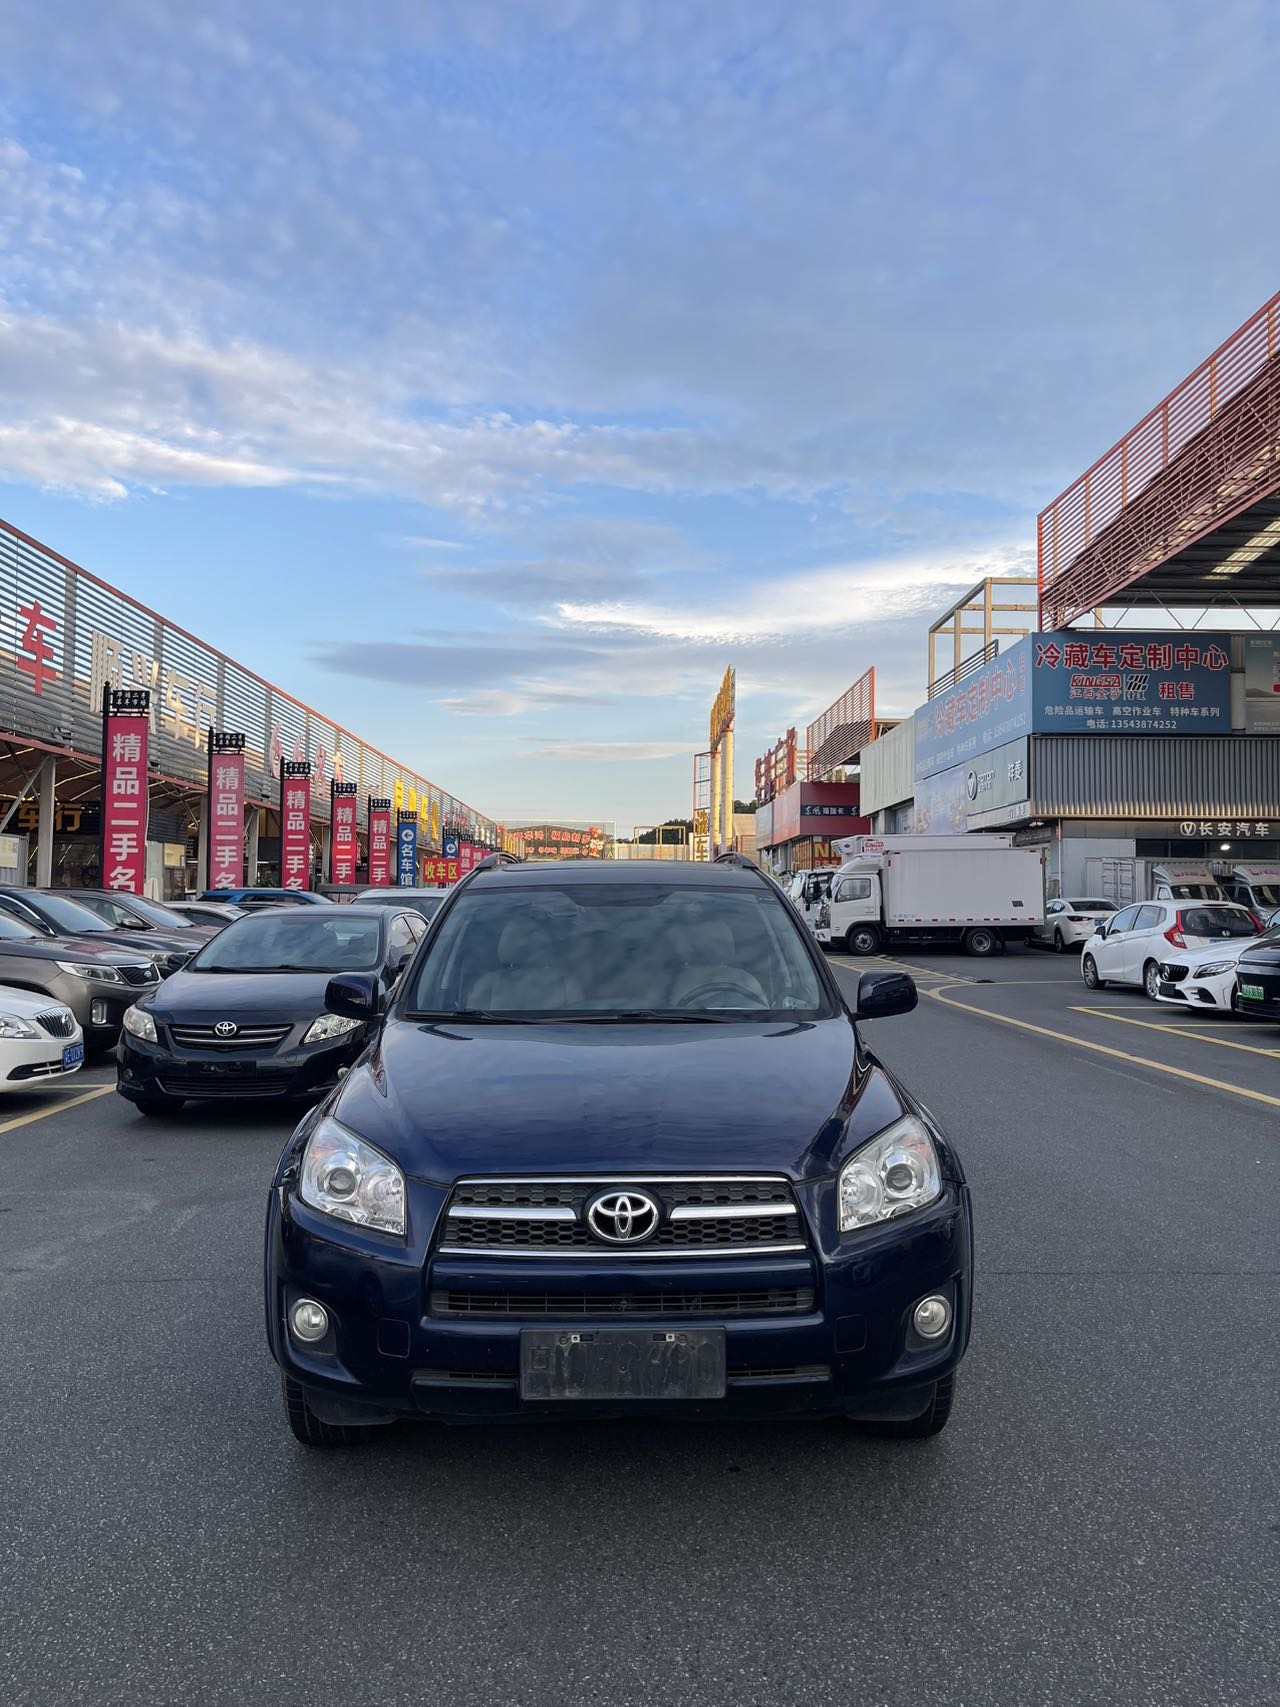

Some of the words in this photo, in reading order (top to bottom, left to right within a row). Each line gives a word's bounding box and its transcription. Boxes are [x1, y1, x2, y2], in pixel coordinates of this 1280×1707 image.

[1035, 642, 1230, 671] 冷藏车定制中心
[1159, 681, 1195, 701] 租售
[1044, 706, 1104, 716] 危险品运输车
[1112, 706, 1162, 716] 高空作业车
[1169, 706, 1220, 717] 特种车系列
[1086, 718, 1110, 729] 电话:
[1111, 719, 1177, 729] 13543874252
[0, 801, 82, 831] 车行
[1199, 822, 1269, 837] 长安汽车
[335, 807, 353, 885] 精品二手
[400, 844, 414, 887] 名车馆
[425, 861, 458, 880] 收车区
